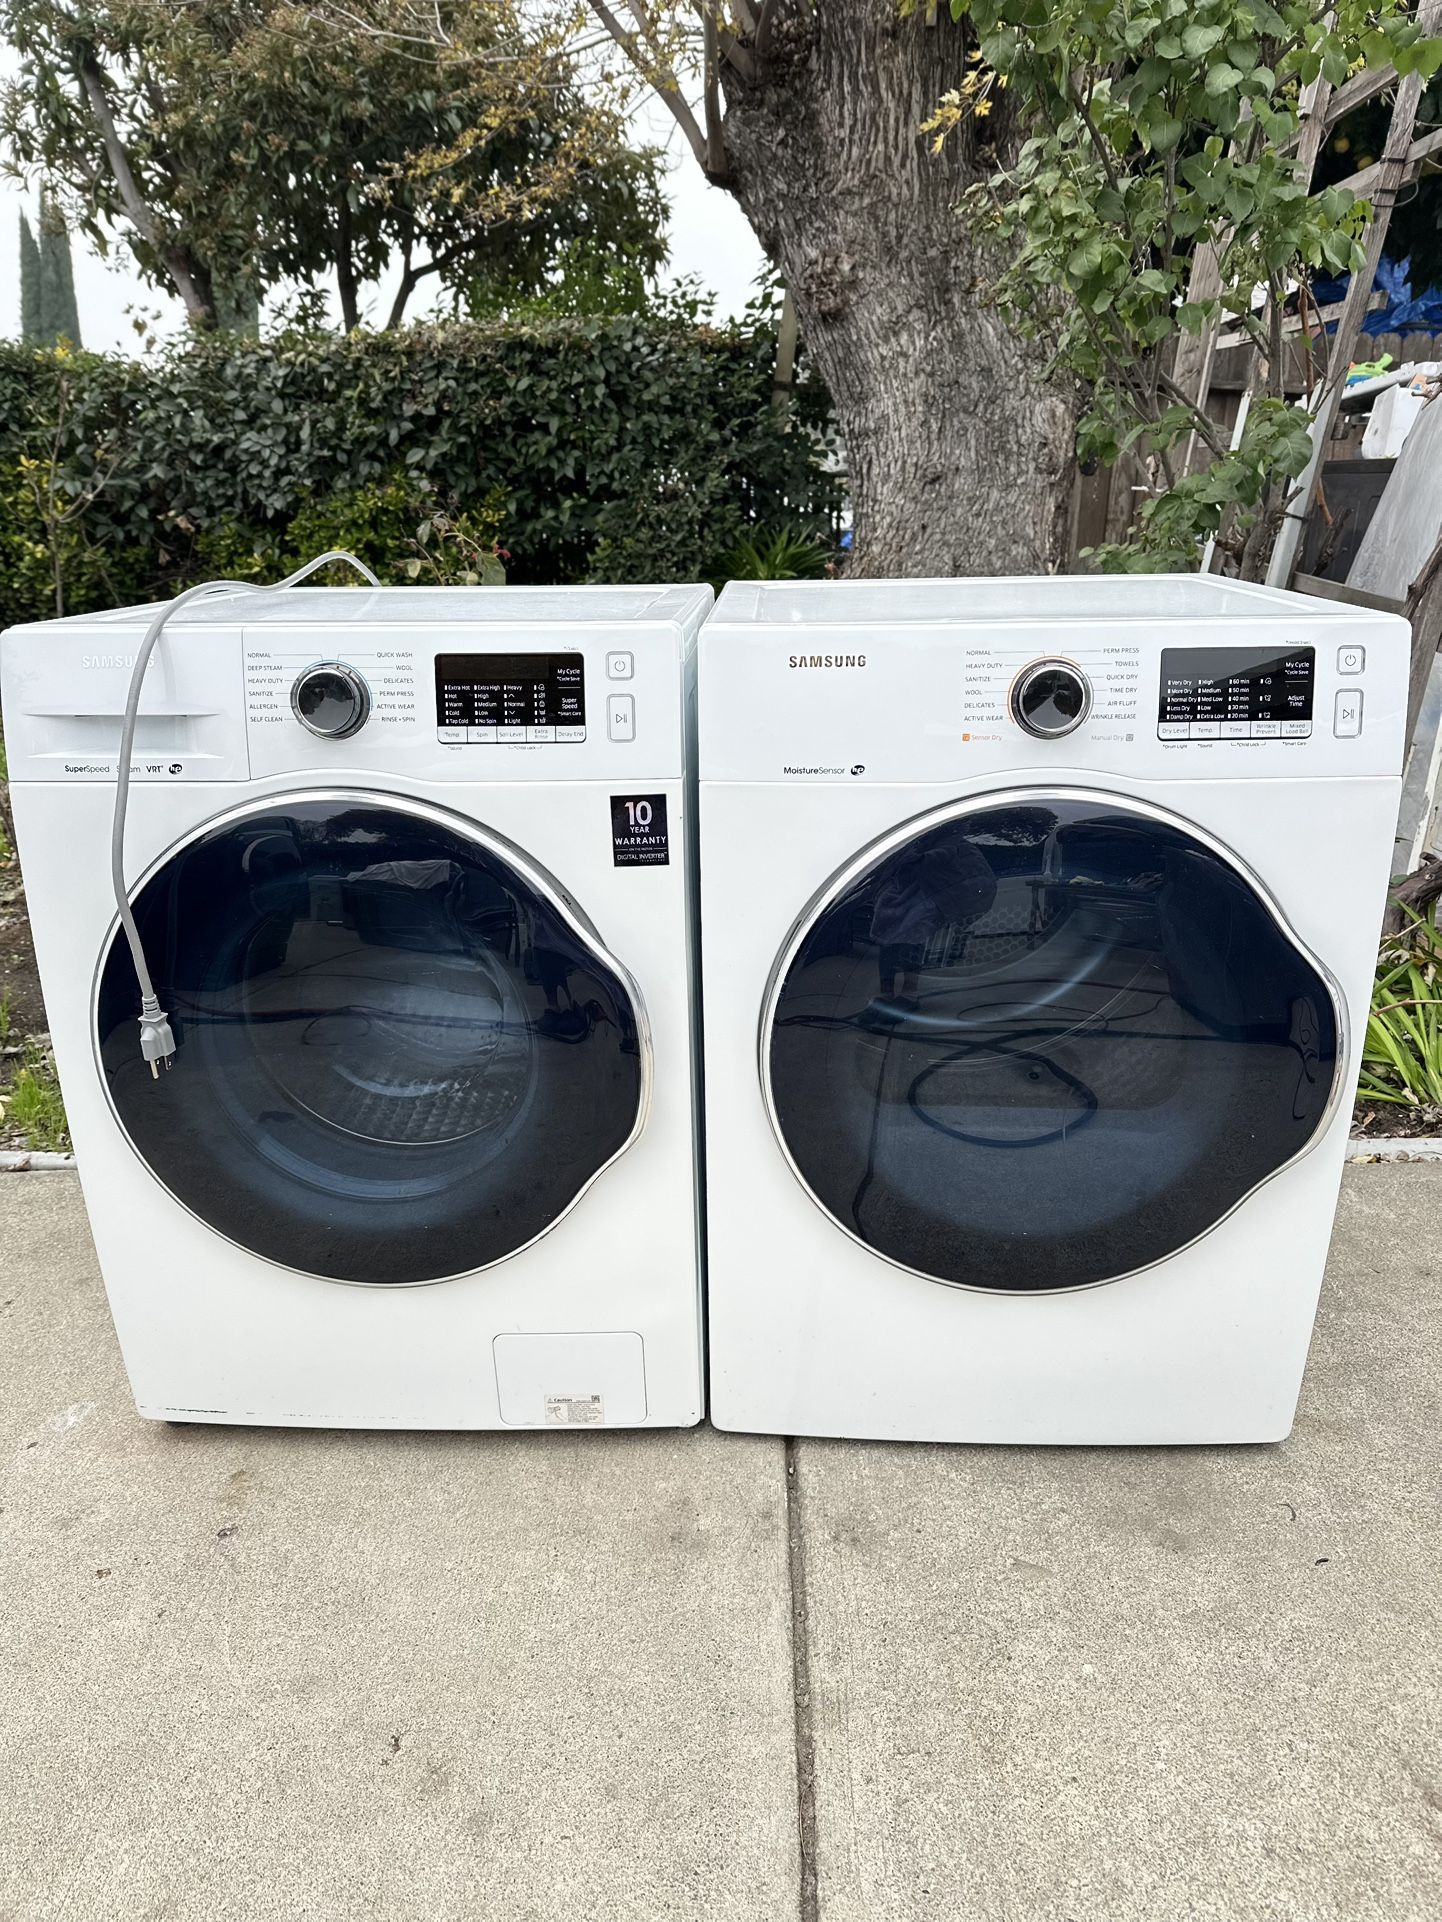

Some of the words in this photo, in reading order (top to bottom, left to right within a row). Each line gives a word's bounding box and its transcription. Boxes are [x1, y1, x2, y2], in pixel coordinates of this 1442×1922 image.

[82, 655, 155, 668] SAMSUG
[788, 655, 866, 668] SAMSUNG
[64, 764, 110, 773] SuperSpeed
[784, 766, 846, 774] MoistureSensor
[624, 800, 652, 826] 10
[614, 836, 666, 845] WARRANTY
